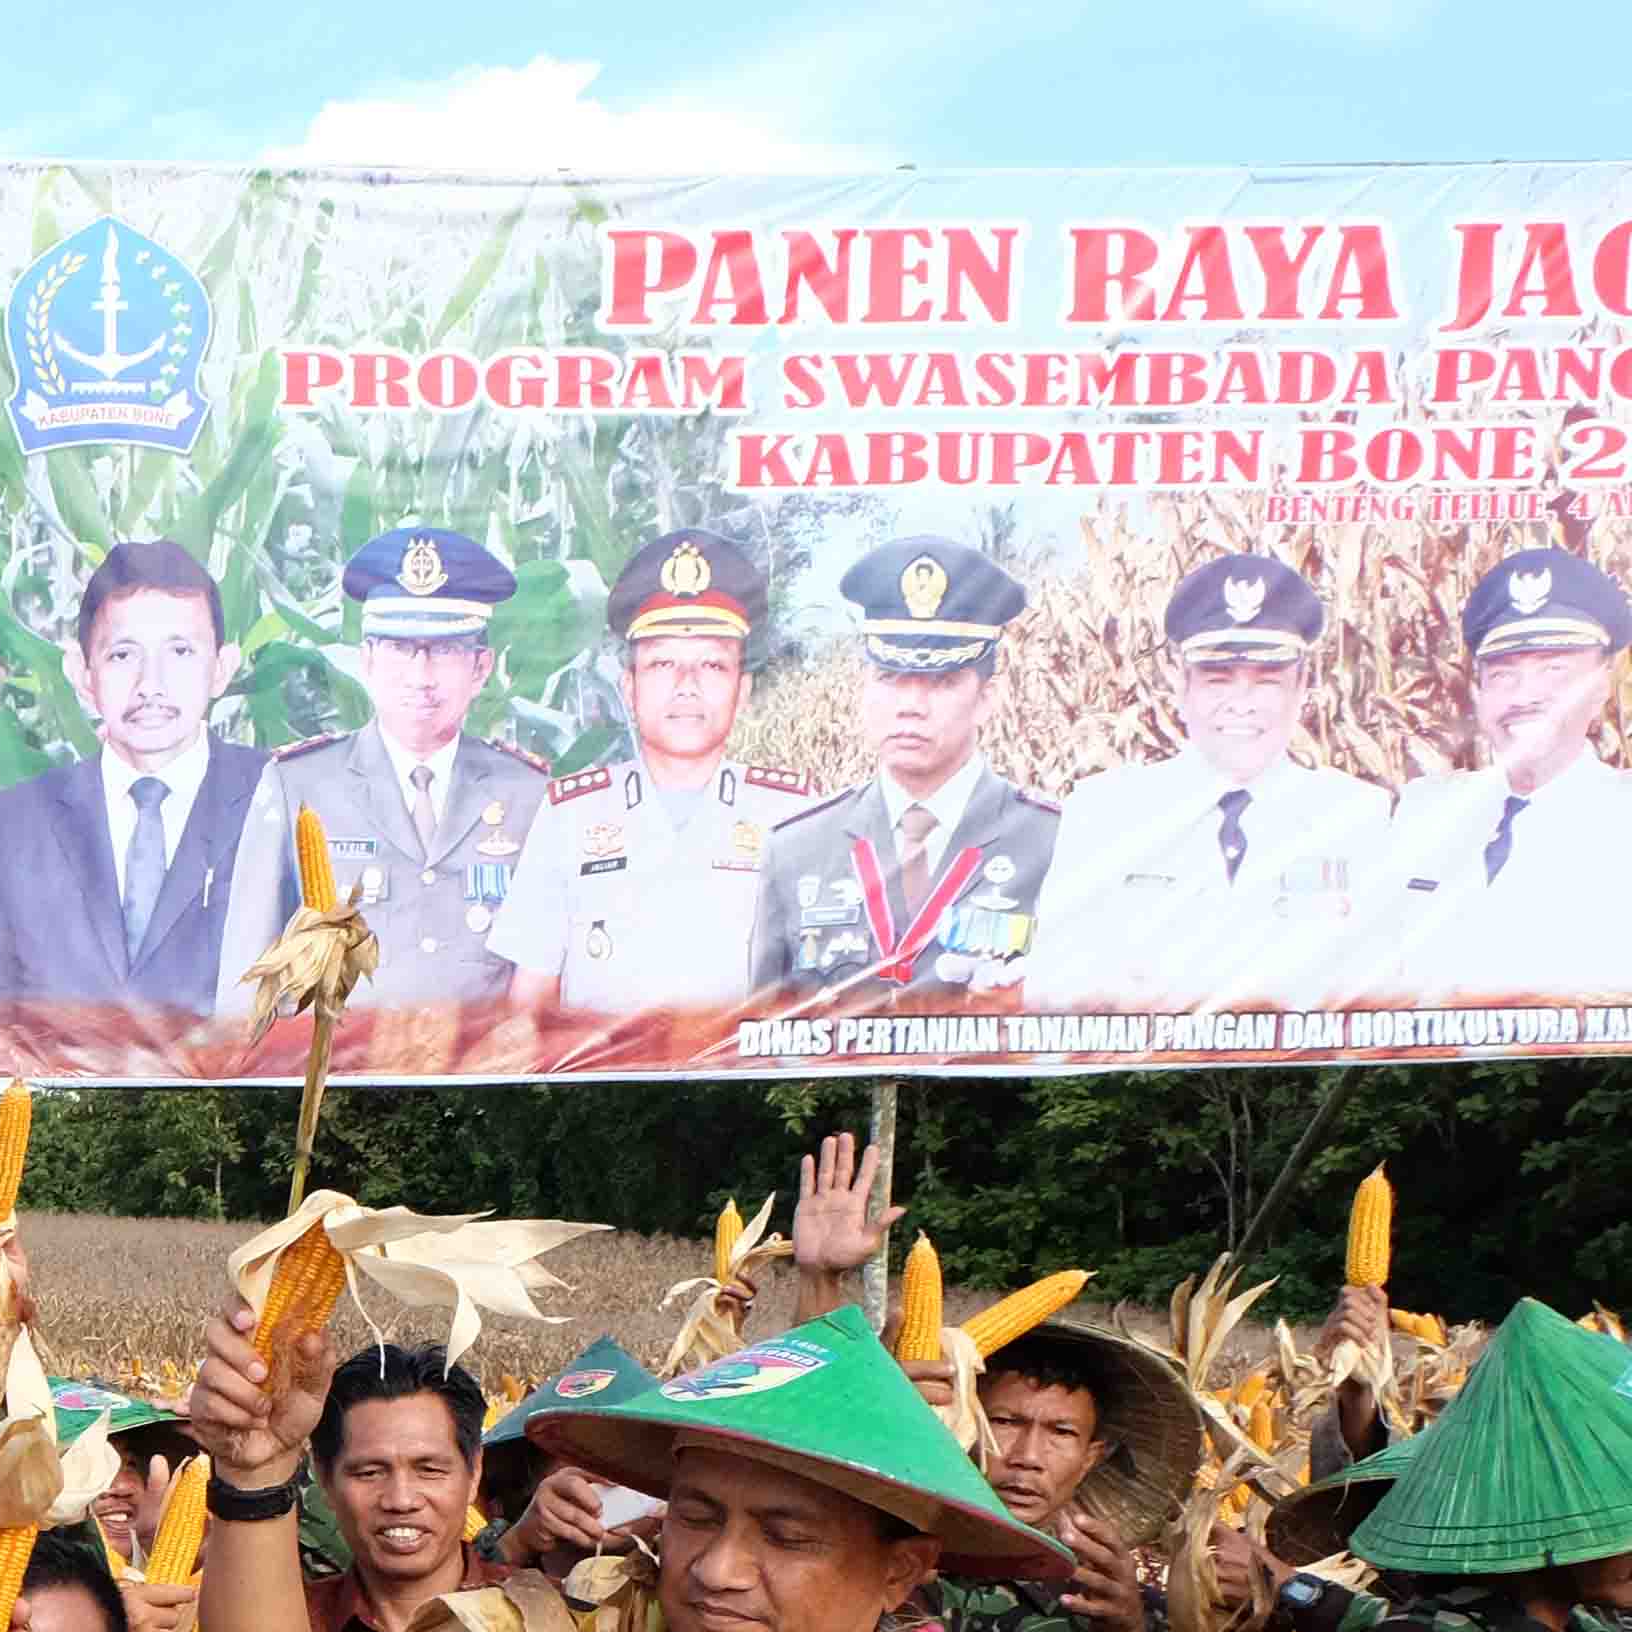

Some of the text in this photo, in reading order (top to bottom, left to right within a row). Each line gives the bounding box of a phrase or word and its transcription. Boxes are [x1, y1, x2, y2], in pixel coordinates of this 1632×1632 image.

[606, 228, 1019, 326] PANEN
[1068, 225, 1397, 322] RAYA
[282, 350, 745, 410] PROGRAM
[783, 348, 1392, 408] SWASEMBADA
[736, 430, 1264, 488] KABUPATEN
[1298, 426, 1537, 484] BONE
[1265, 495, 1415, 522] BENTENG
[738, 1017, 832, 1057] DINAS
[837, 1015, 999, 1055] PERTANIAN
[1005, 1015, 1147, 1053] TANAMAN
[1153, 1013, 1276, 1051] PANGAN
[1281, 1011, 1344, 1050] DAN
[1349, 1008, 1578, 1047] HORTIKULTURA
